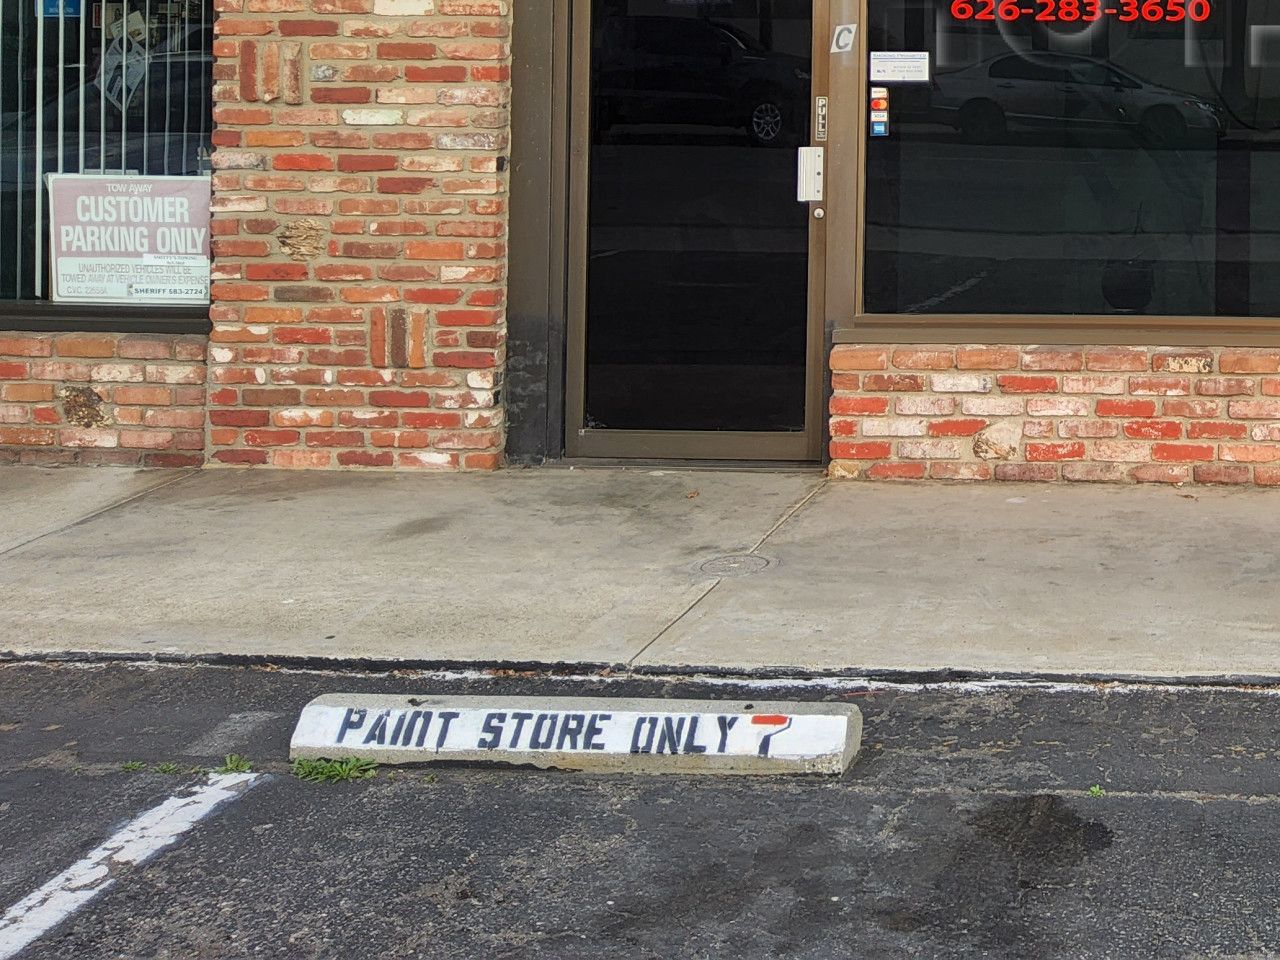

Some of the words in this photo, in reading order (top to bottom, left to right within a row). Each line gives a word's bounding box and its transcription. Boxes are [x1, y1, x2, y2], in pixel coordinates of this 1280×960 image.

[835, 26, 852, 50] C
[818, 98, 826, 131] PULL
[106, 183, 126, 192] TOW
[128, 184, 153, 193] AWAY
[76, 195, 189, 223] CUSTOMER
[60, 225, 149, 252] PARKING
[156, 227, 207, 253] ONLY
[62, 274, 87, 283] TOWED
[87, 274, 105, 283] AWAY
[106, 274, 115, 284] AT
[115, 274, 144, 284] VEHICLE
[178, 275, 209, 285] EXPENSE
[78, 263, 130, 274] UNAUTHORIZED
[131, 265, 164, 275] VEHICLES
[165, 266, 182, 275] WILL
[182, 266, 192, 275] BE
[336, 707, 460, 749] PAINT
[477, 712, 612, 750] STORE
[630, 715, 738, 754] ONLY
